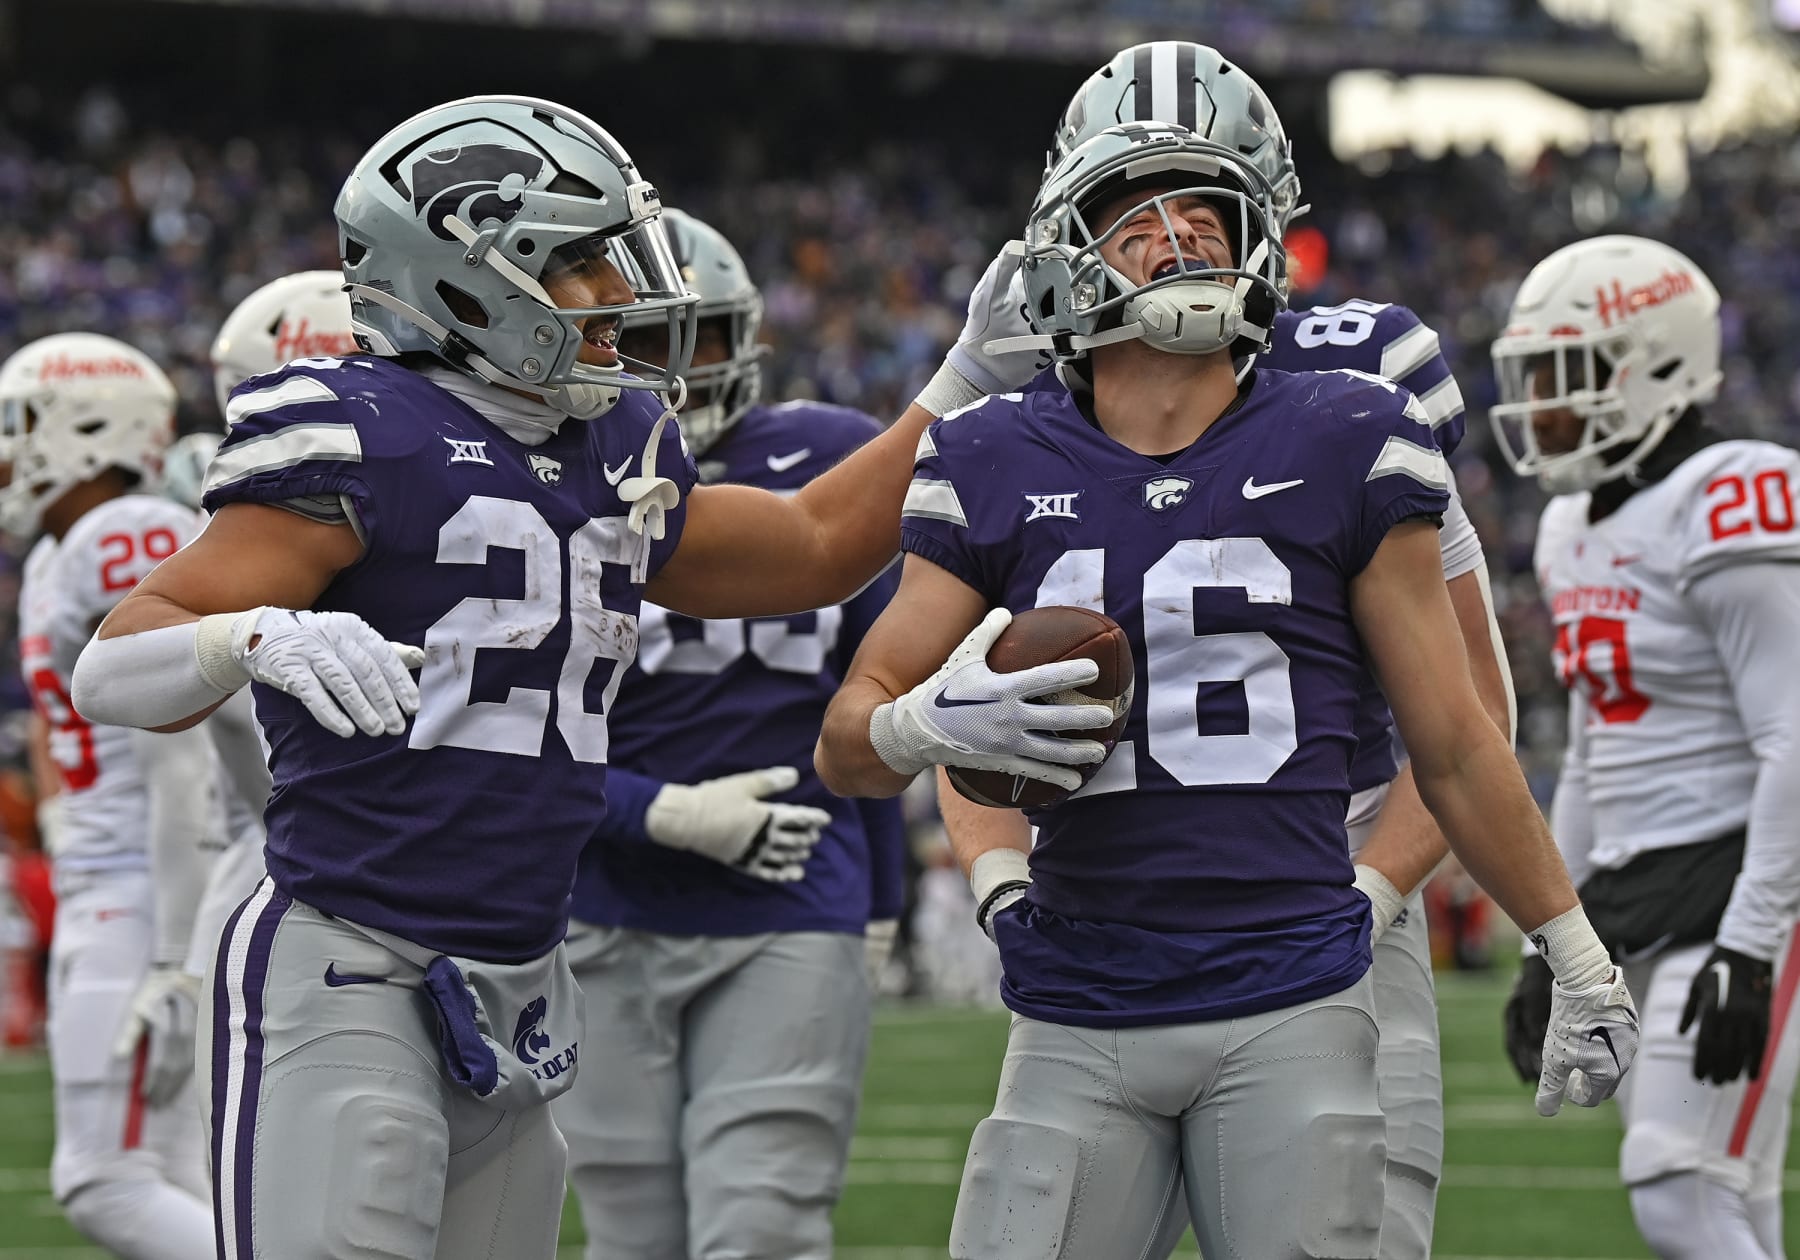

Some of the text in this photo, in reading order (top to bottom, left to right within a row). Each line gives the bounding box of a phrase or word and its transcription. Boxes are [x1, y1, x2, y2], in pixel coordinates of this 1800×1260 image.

[1705, 469, 1795, 543] 20
[98, 527, 179, 592] 29
[408, 495, 650, 764] 26
